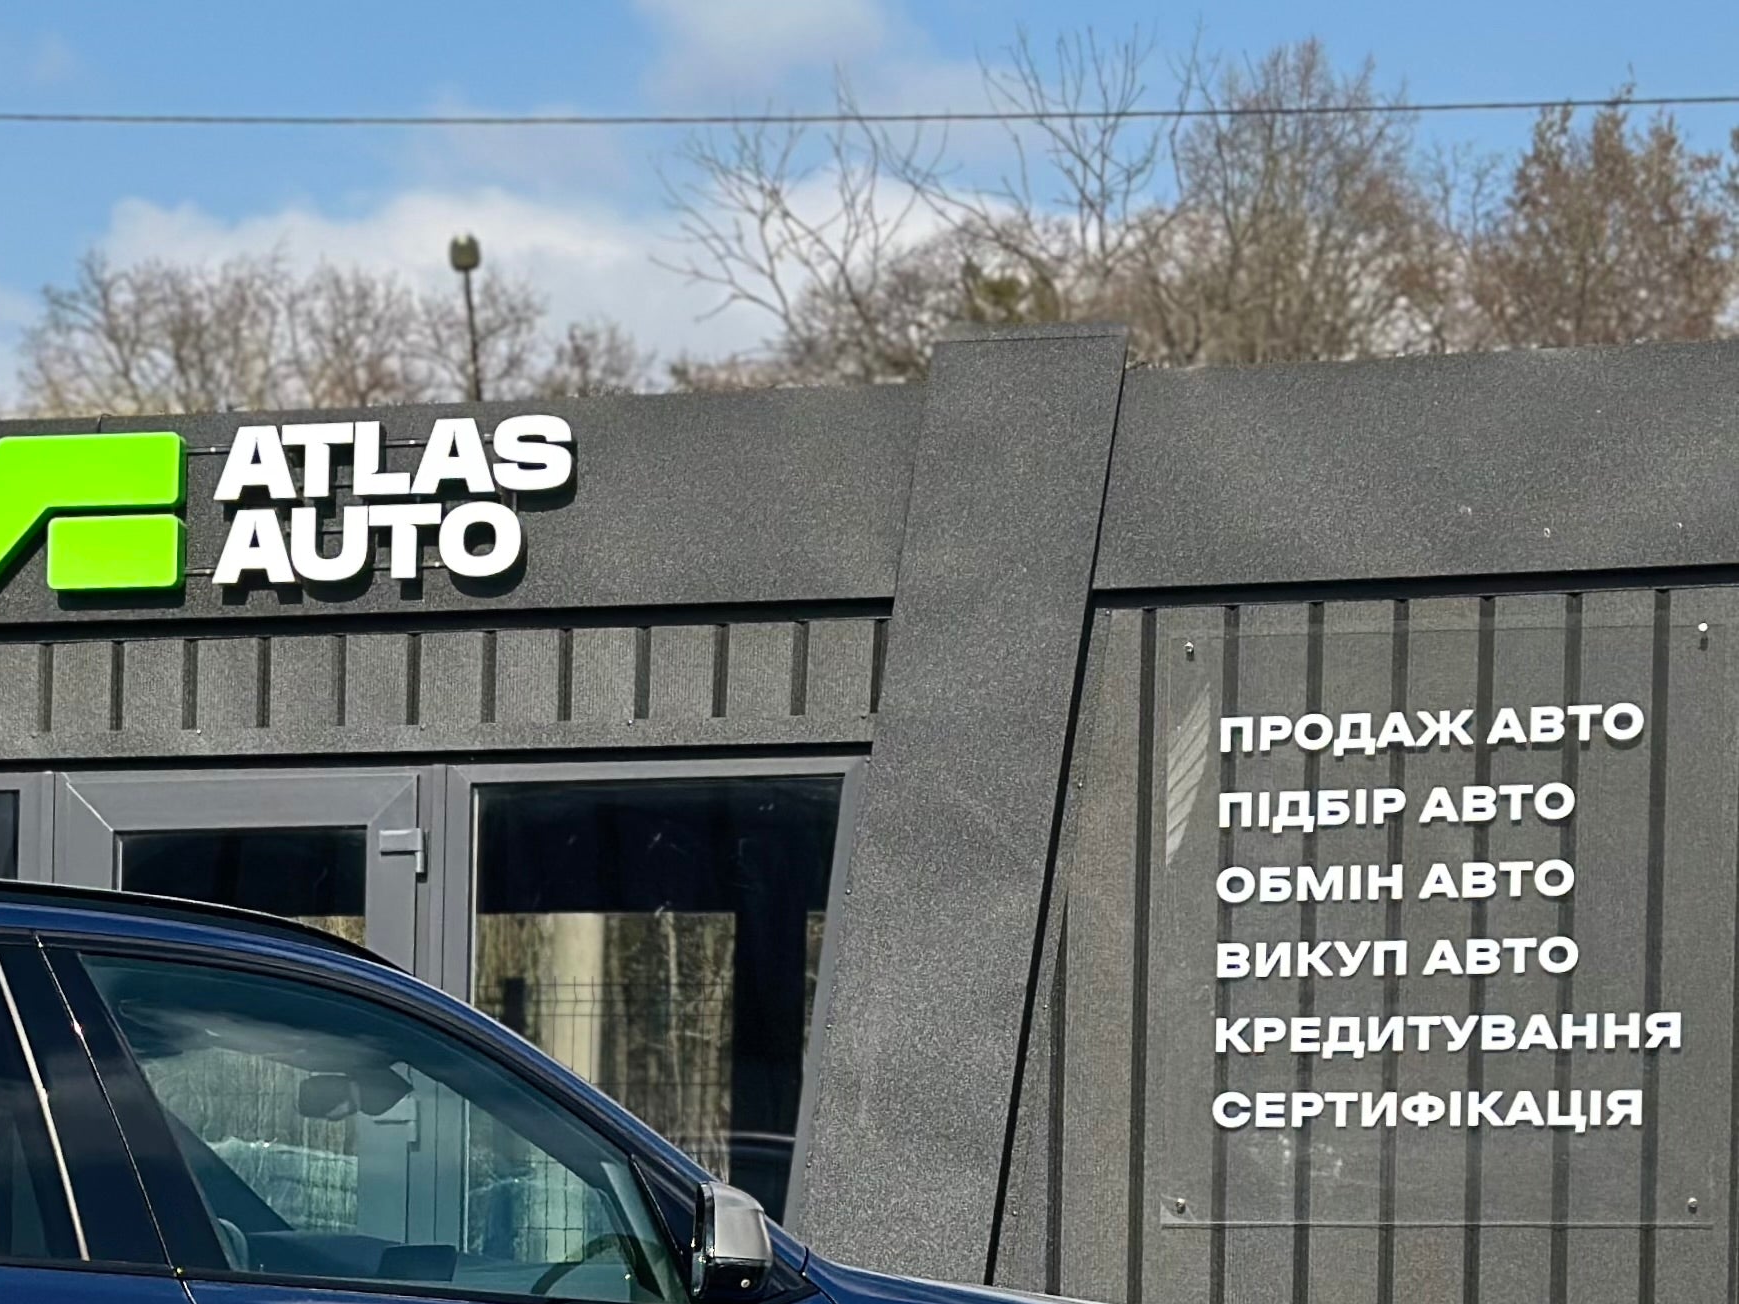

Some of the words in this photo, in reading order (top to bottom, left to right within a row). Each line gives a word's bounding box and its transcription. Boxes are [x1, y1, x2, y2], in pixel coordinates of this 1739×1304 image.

[214, 415, 572, 501] ATLAS
[212, 501, 522, 585] AUTO
[1219, 709, 1475, 756] ПРОДАЖ
[1486, 702, 1645, 745] АВТО
[1218, 788, 1407, 834] ПІДБІР
[1418, 782, 1576, 823] АВТО
[1215, 863, 1404, 903] ОБМІН
[1418, 859, 1575, 900] АВТО
[1216, 939, 1408, 978] ВИКУП
[1422, 936, 1579, 976] АВТО
[1215, 1011, 1682, 1059] КРЕДИТУВАННЯ
[1211, 1089, 1643, 1133] СЕРТИФІКАЦІЯ
